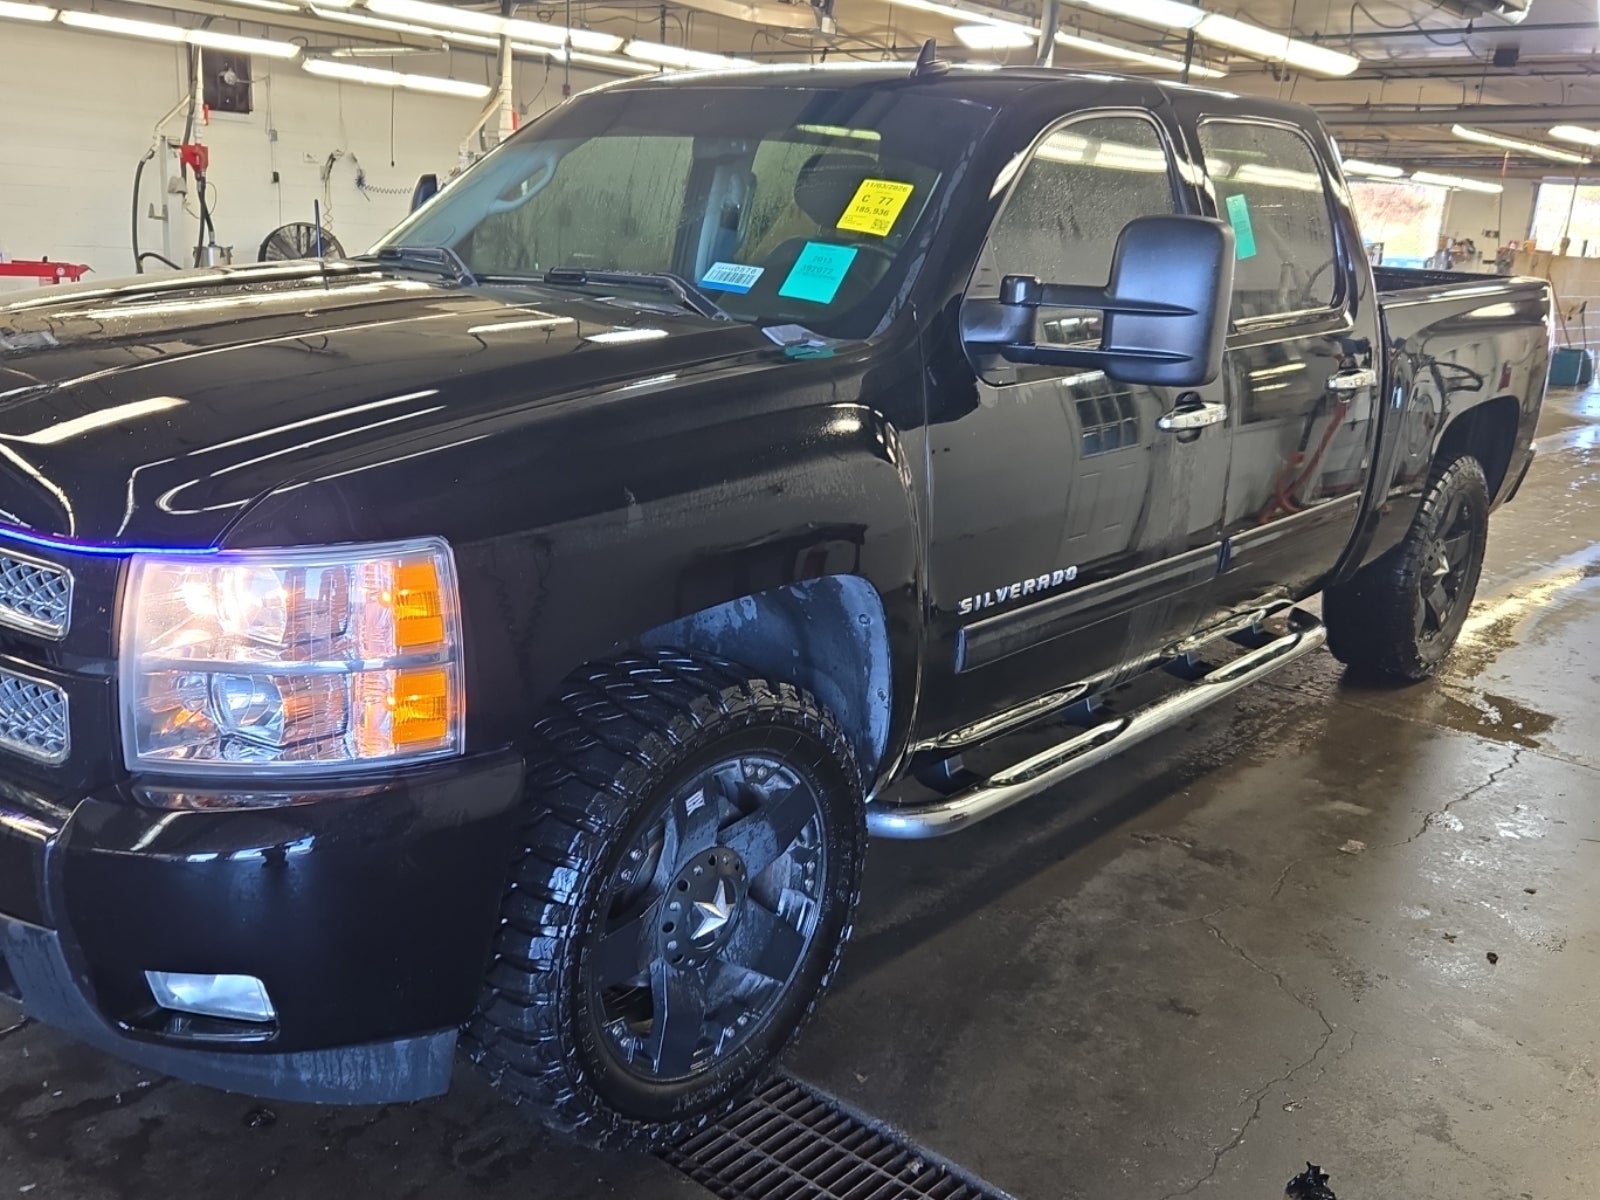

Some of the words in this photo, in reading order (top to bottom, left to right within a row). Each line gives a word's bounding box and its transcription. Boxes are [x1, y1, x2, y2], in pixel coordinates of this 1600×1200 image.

[861, 194, 871, 203] C
[878, 195, 895, 206] 77
[957, 564, 1079, 616] SILVERADO
